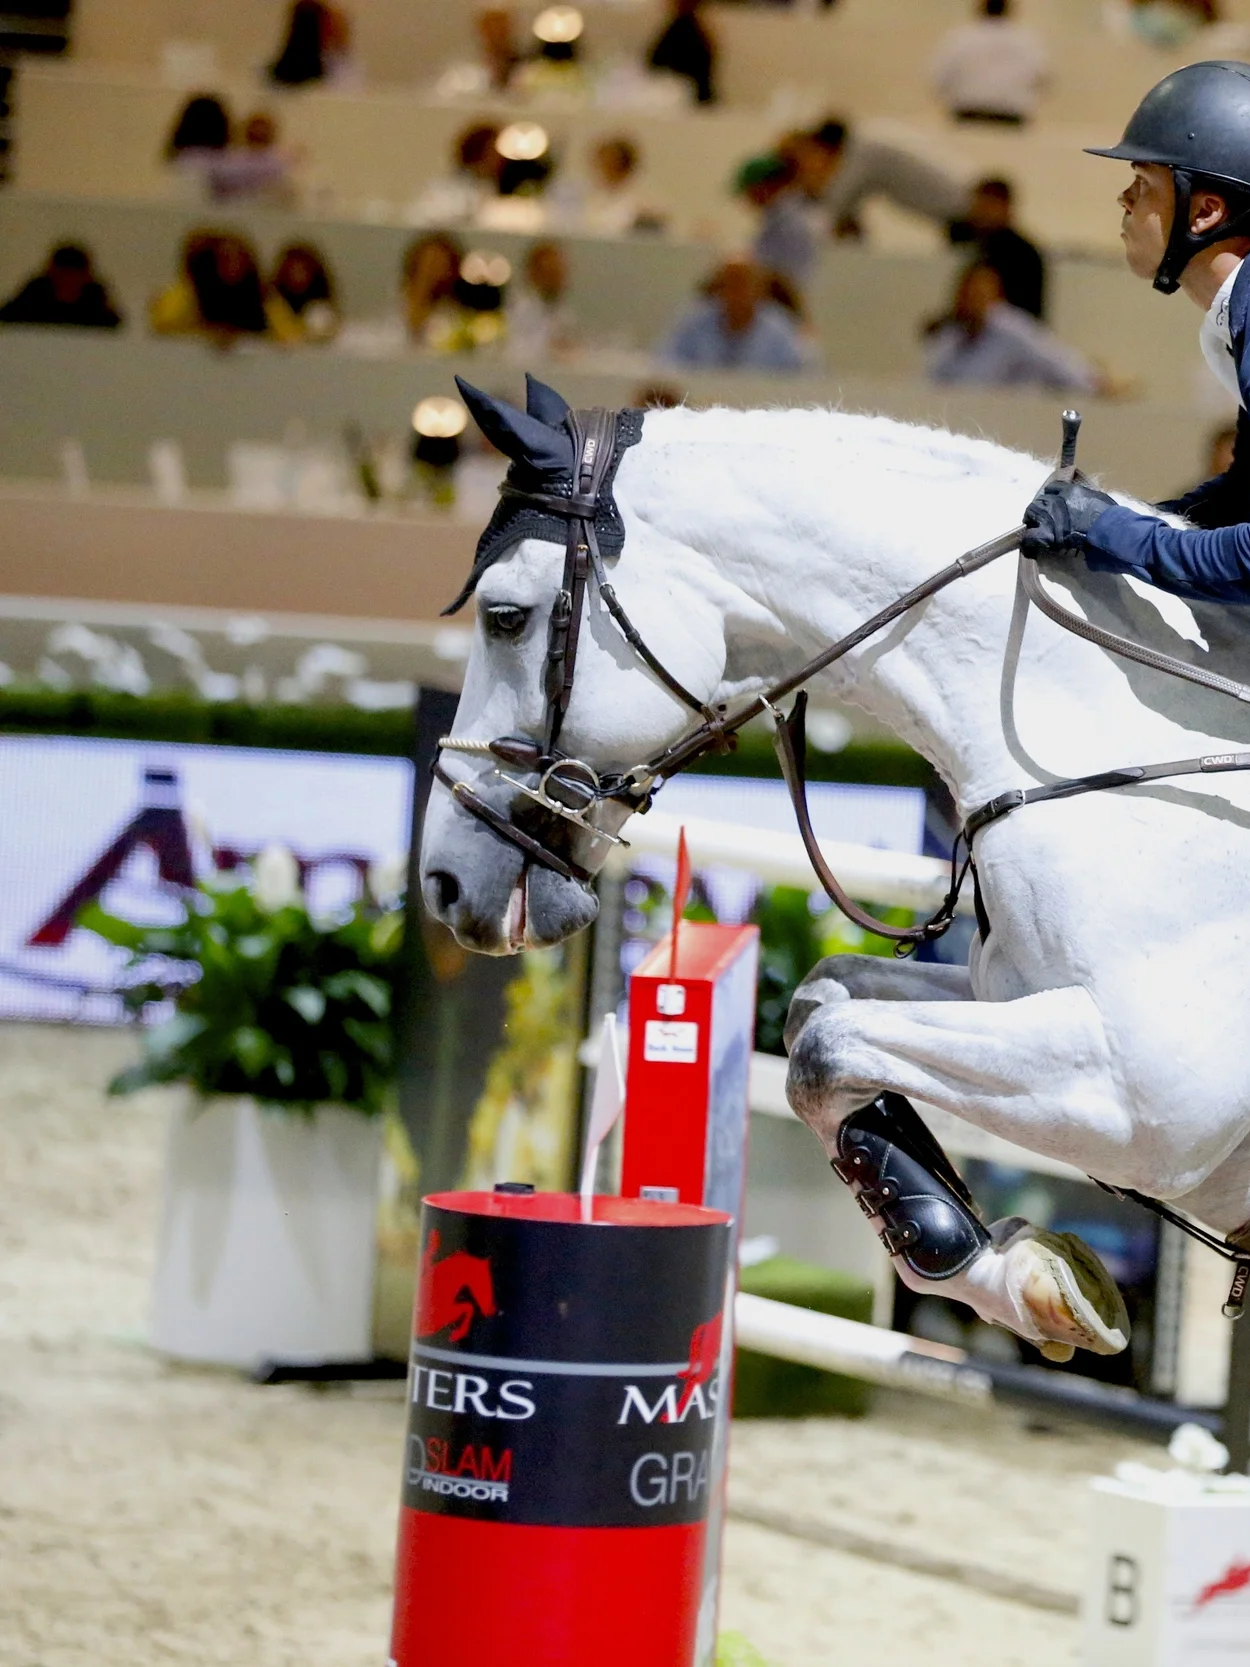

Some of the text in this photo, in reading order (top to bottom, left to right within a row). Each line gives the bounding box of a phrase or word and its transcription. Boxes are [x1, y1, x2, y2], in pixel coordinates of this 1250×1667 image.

[584, 440, 596, 464] CWD
[1203, 755, 1232, 766] CWD
[1231, 1266, 1249, 1298] CWD
[422, 1478, 509, 1503] INDOOR
[1106, 1552, 1143, 1629] B
